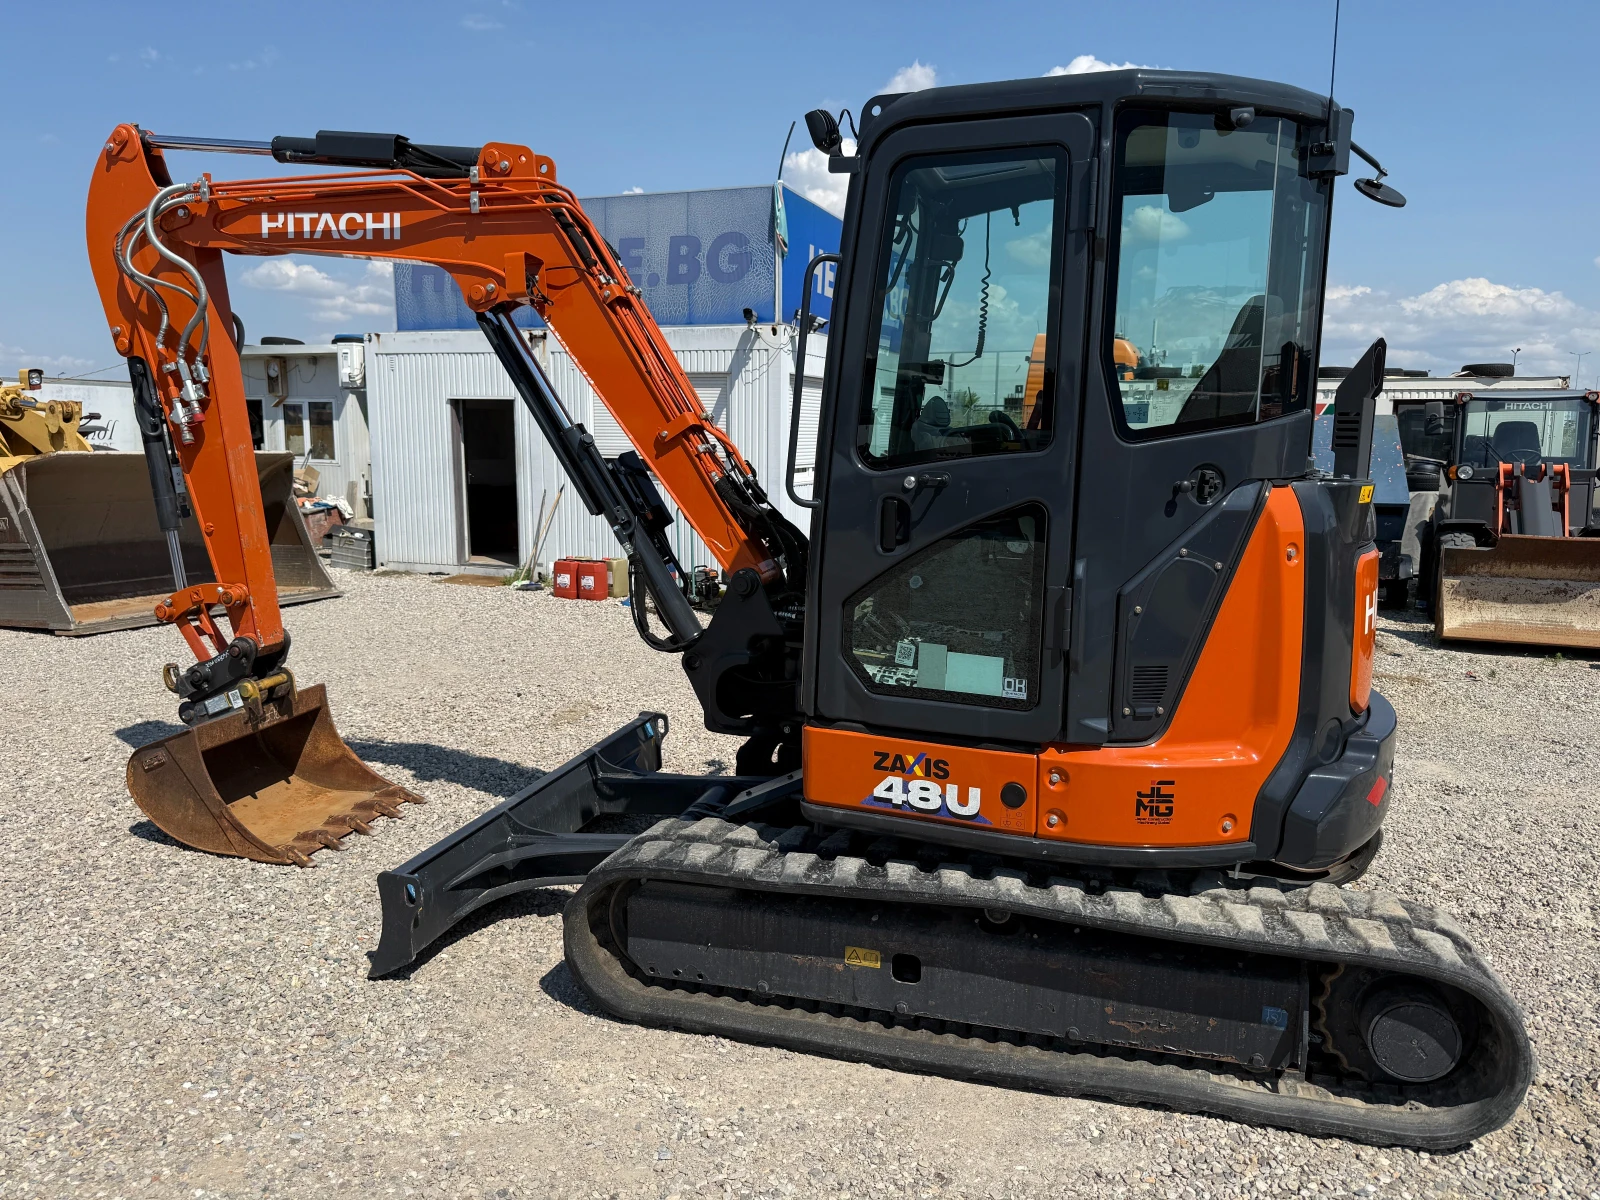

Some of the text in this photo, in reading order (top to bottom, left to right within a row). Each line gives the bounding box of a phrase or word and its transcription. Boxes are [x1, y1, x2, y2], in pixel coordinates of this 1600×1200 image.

[261, 212, 401, 240] HITACHI
[1504, 402, 1553, 410] HITACHI
[873, 751, 950, 780] ZAXIS
[873, 776, 981, 819] 48U
